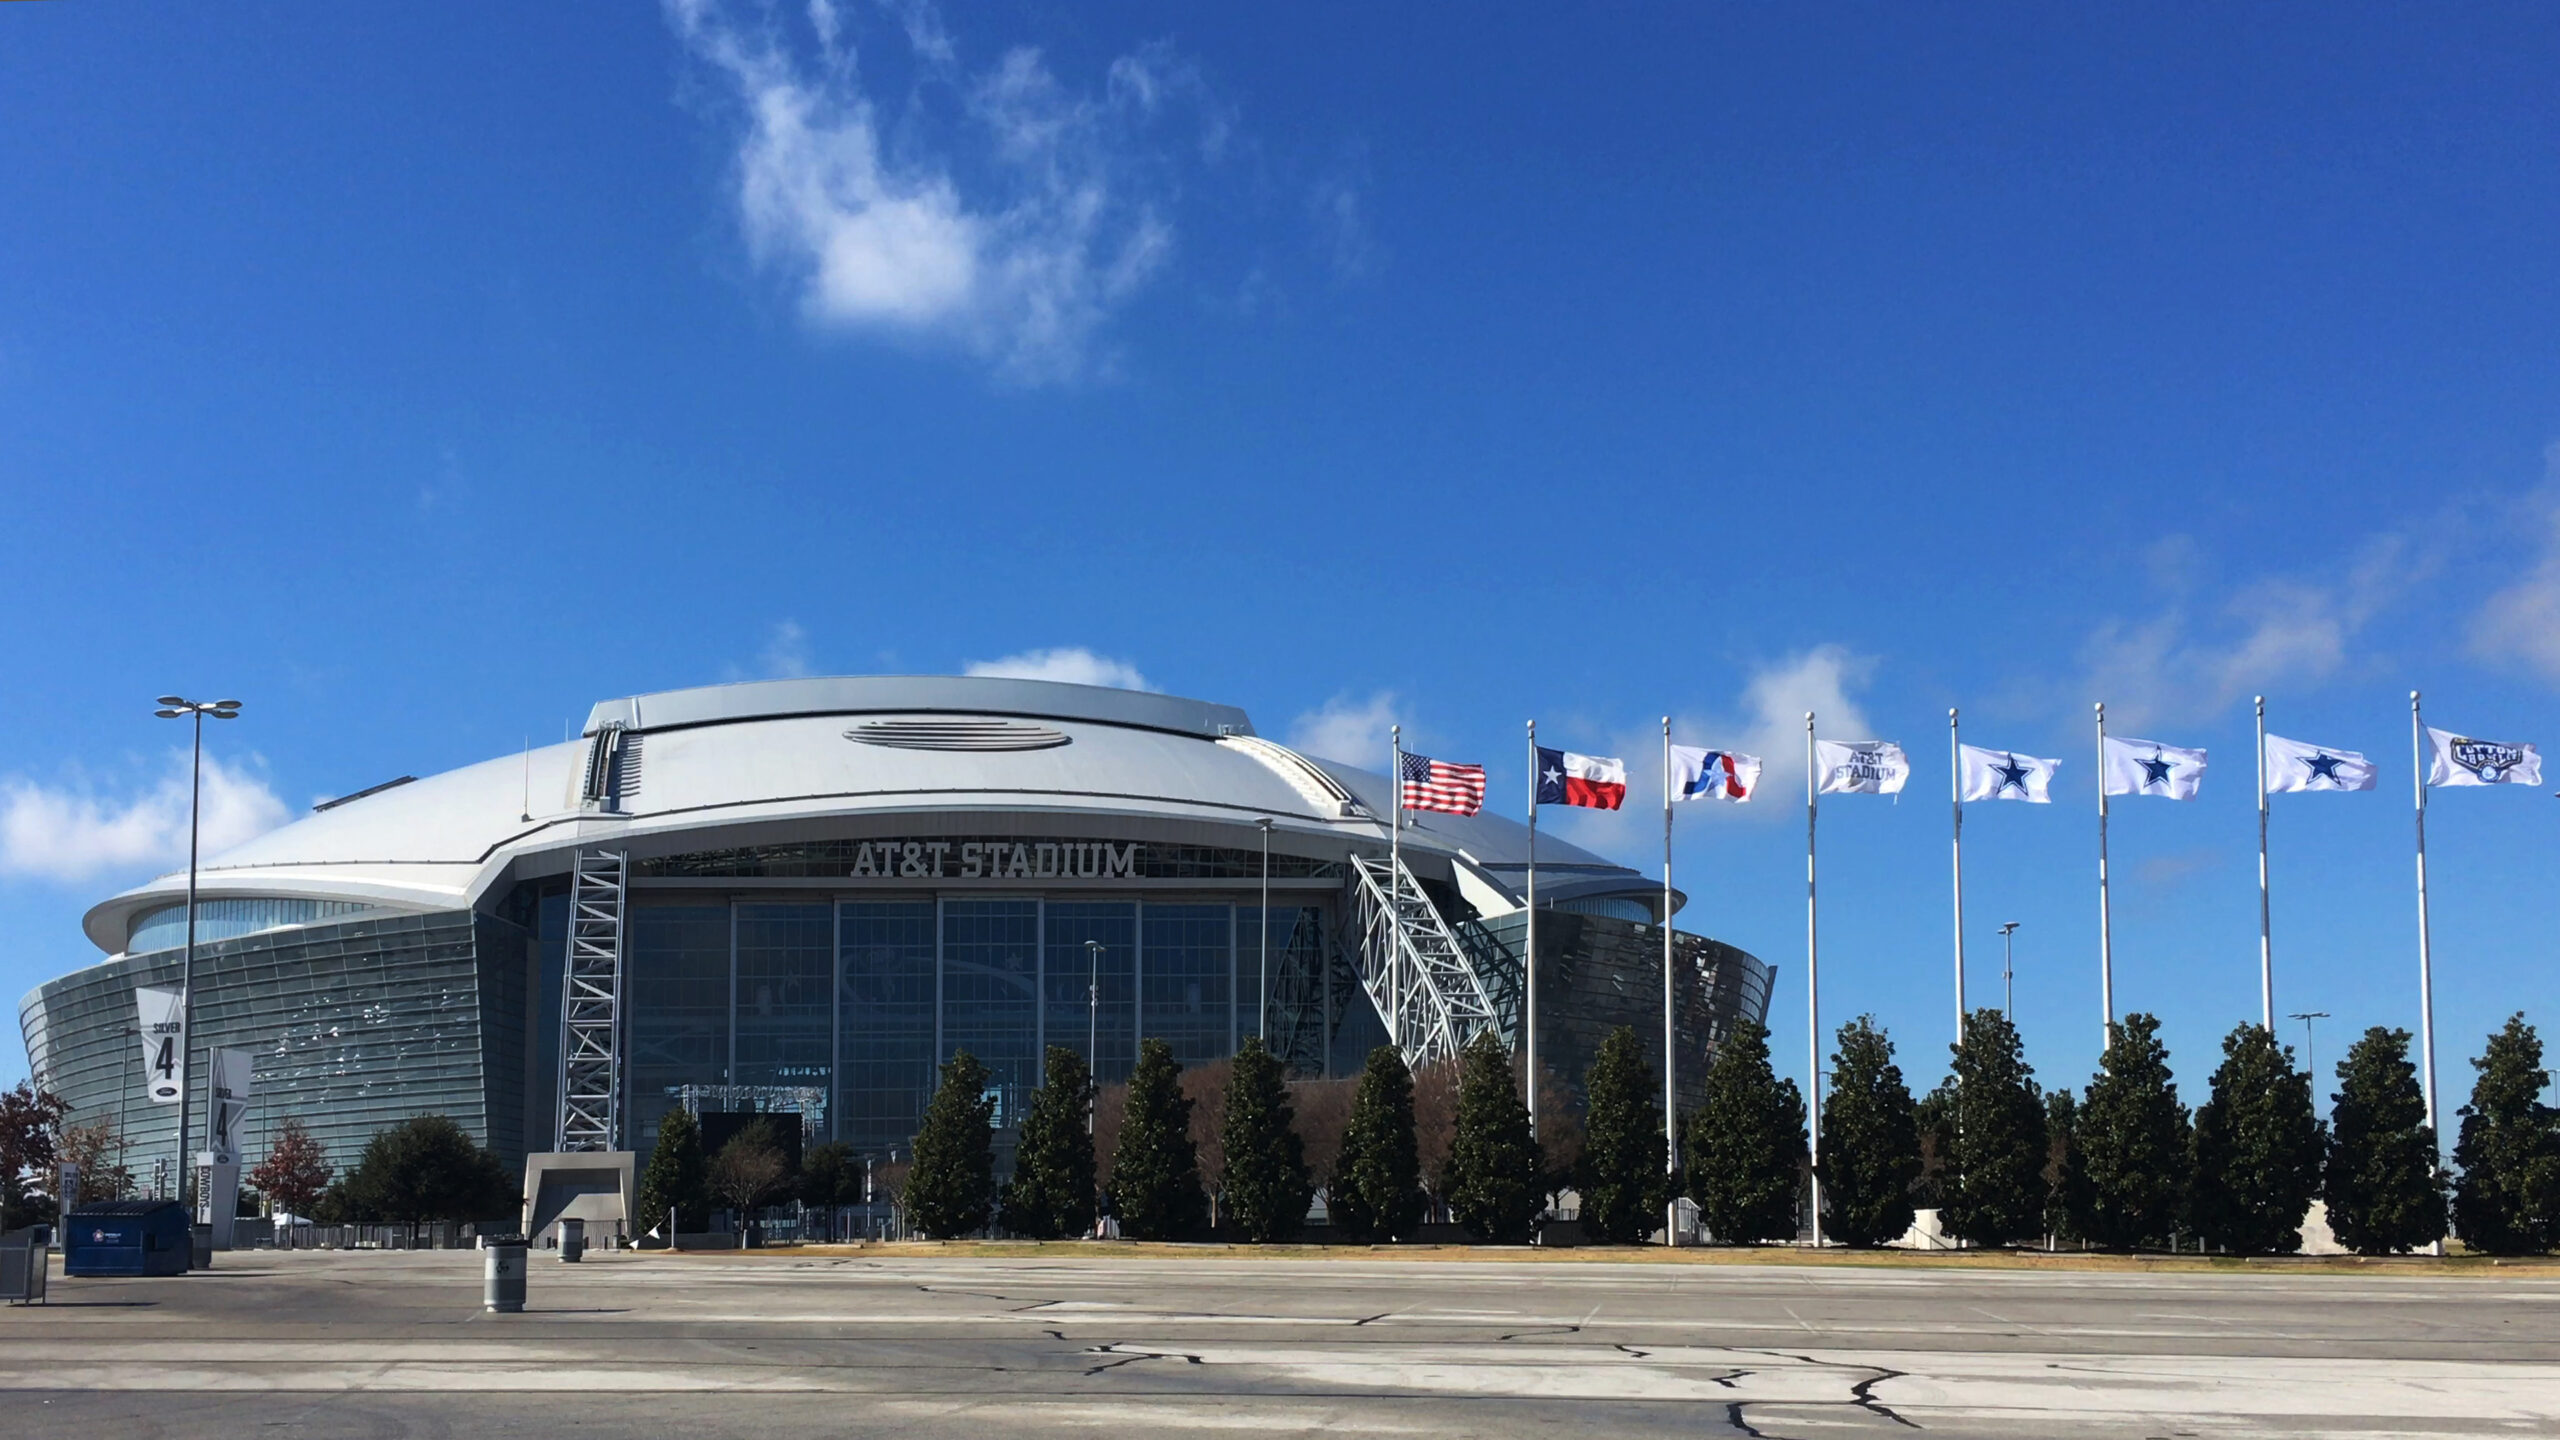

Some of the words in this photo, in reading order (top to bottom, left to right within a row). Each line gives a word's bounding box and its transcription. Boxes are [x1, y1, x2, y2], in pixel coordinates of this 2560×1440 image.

[1835, 764, 1896, 781] STADIUM
[1848, 751, 1884, 765] AT&T
[850, 841, 950, 878] AT&T
[961, 842, 1137, 878] STADIUM
[153, 1022, 181, 1034] SILVER
[155, 1037, 174, 1079] 4
[216, 1102, 227, 1146] 4
[199, 1166, 211, 1208] COWBOYS
